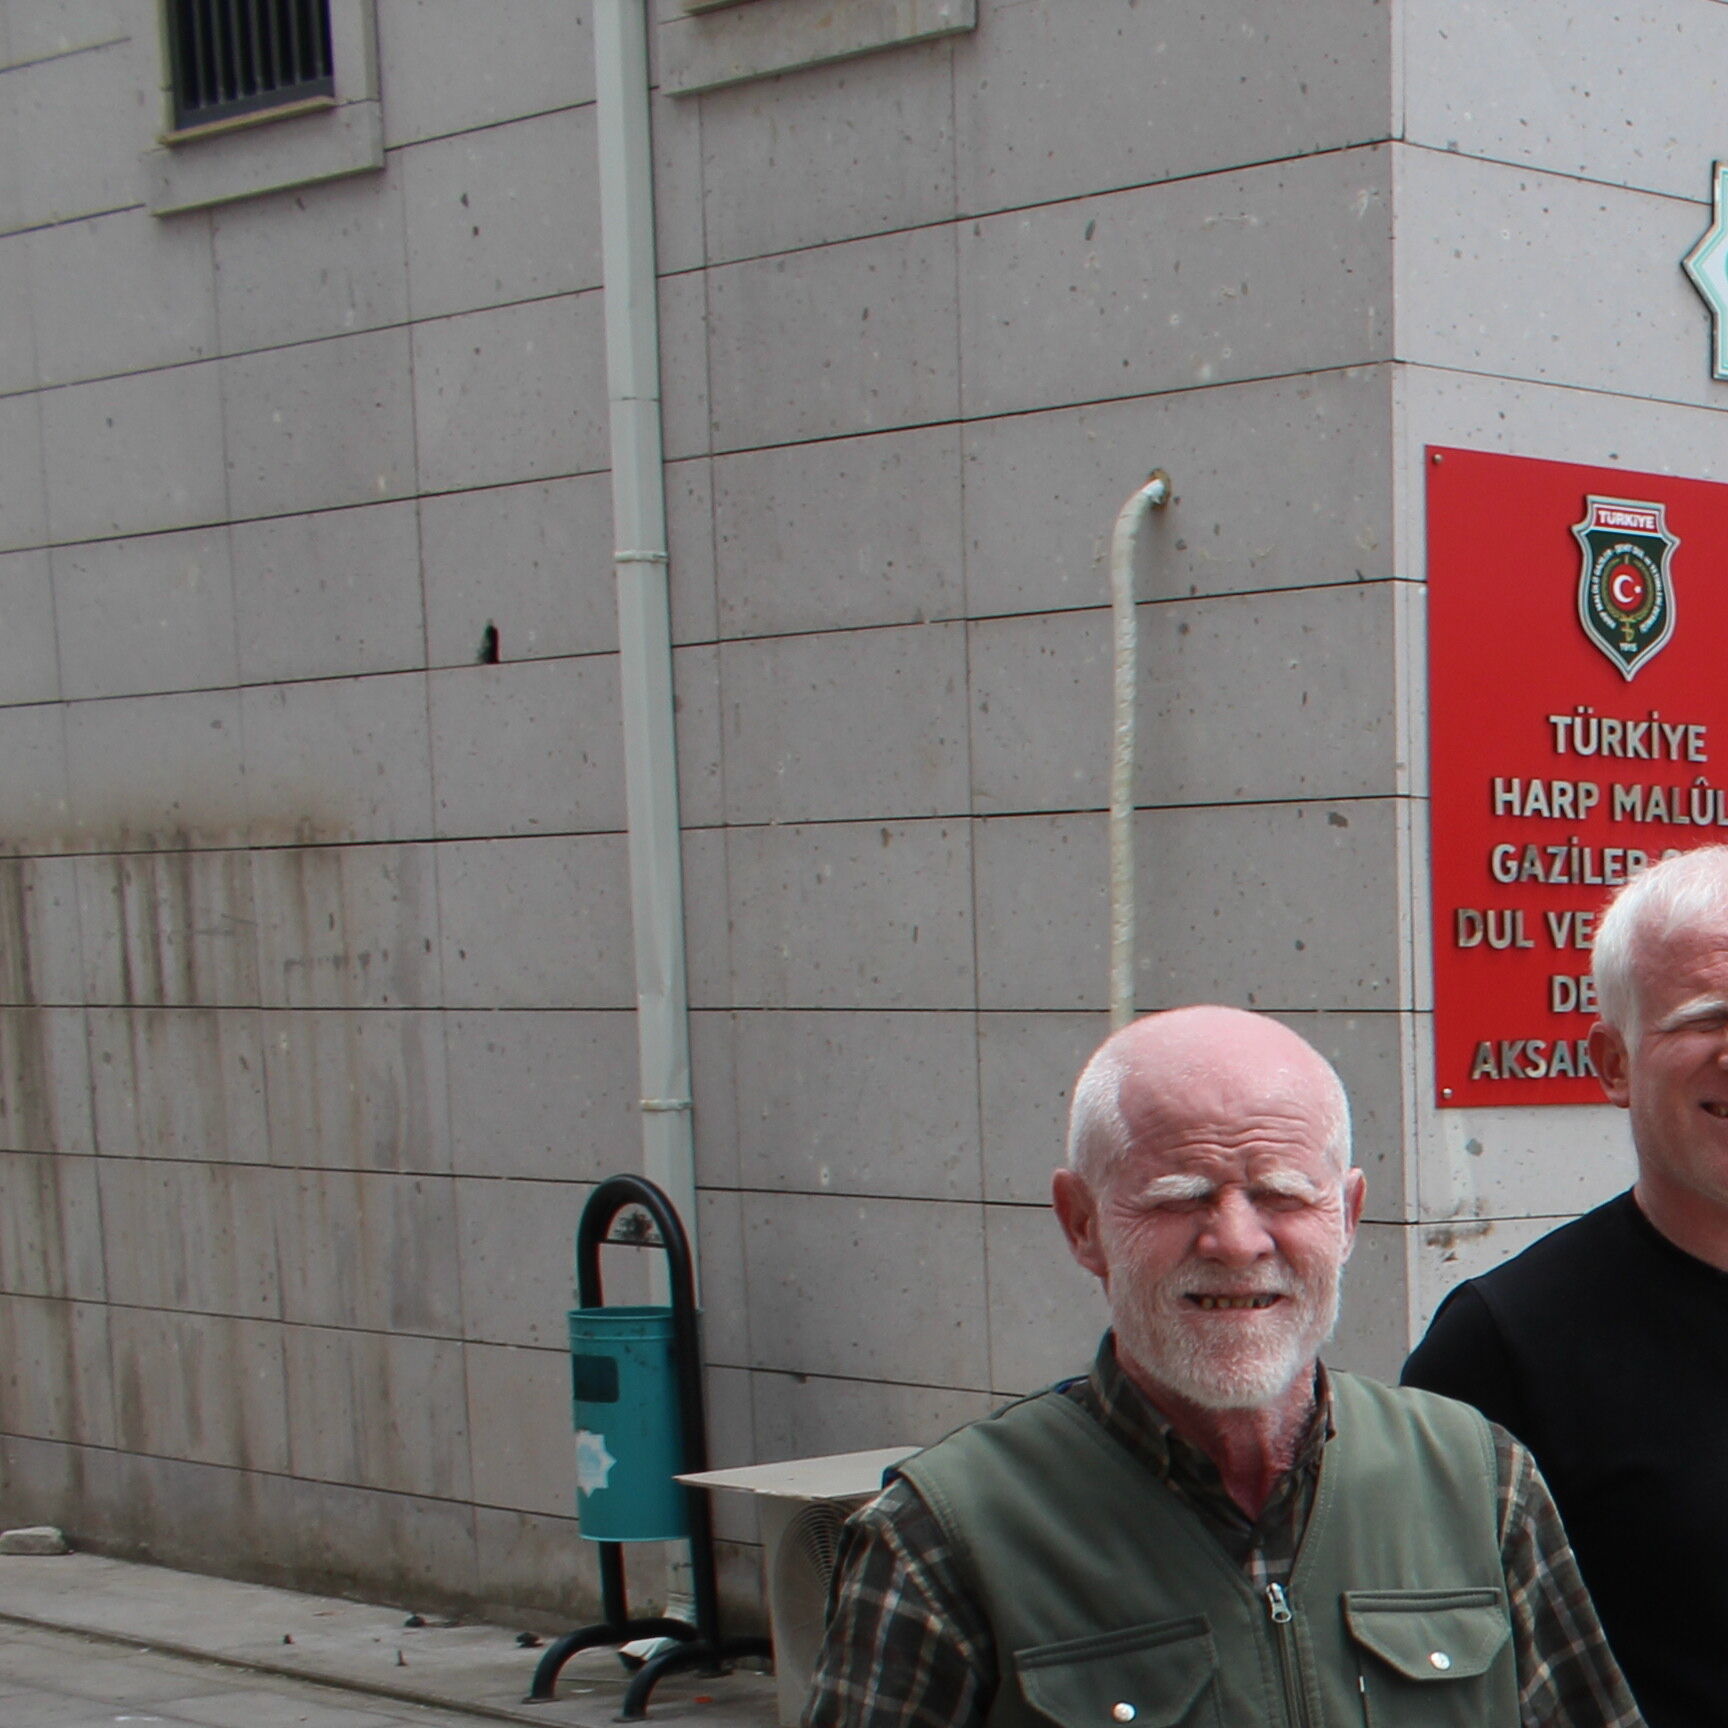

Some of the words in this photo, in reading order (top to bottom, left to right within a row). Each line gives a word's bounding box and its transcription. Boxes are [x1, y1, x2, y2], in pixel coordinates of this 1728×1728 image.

[1549, 706, 1709, 762] TÜRKİYE
[1493, 777, 1599, 819] HARP
[1457, 908, 1536, 949] DUL
[1547, 911, 1596, 949] VE
[1471, 1039, 1600, 1080] AKSAR
